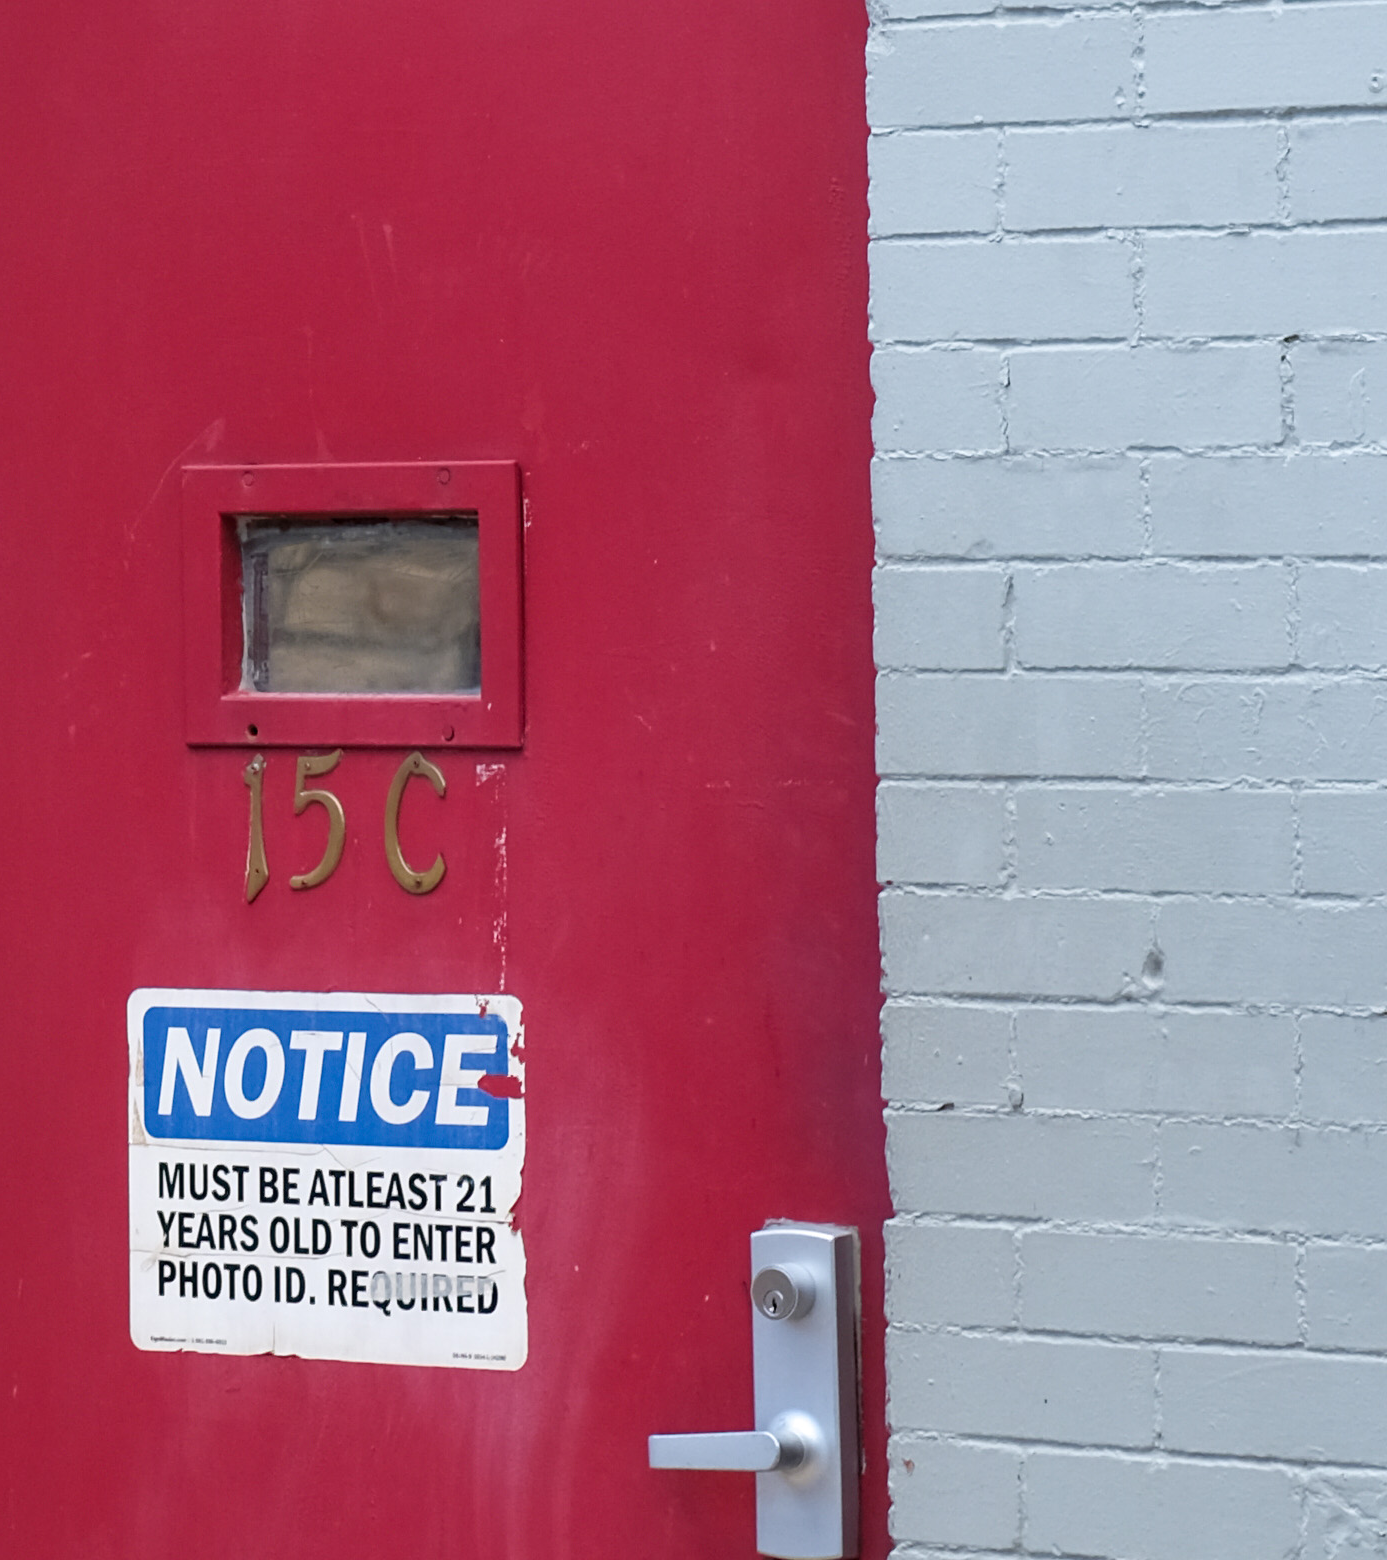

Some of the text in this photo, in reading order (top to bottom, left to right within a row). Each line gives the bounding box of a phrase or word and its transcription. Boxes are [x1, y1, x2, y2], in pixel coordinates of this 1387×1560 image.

[157, 1026, 499, 1127] NOTICE
[158, 1162, 250, 1202] MUST
[258, 1166, 301, 1205] BE
[456, 1175, 497, 1213] 21
[157, 1210, 497, 1264] YEARS OLD TO ENTER
[158, 1260, 499, 1316] PHOTO ID. REQUIRED
